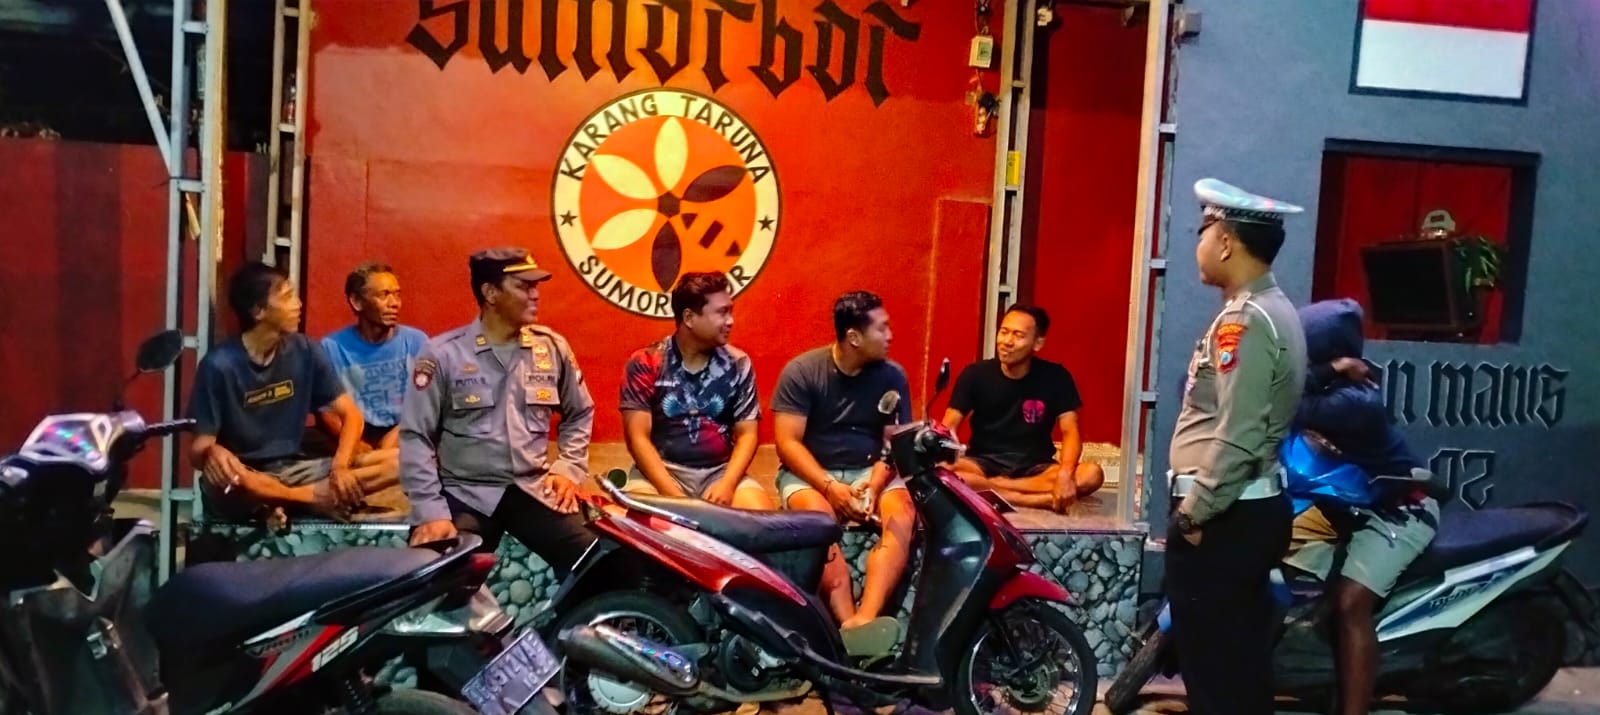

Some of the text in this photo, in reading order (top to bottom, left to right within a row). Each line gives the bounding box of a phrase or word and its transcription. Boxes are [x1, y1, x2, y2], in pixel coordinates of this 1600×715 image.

[560, 94, 771, 184] KARANG TARUNA
[311, 625, 360, 673] 125
